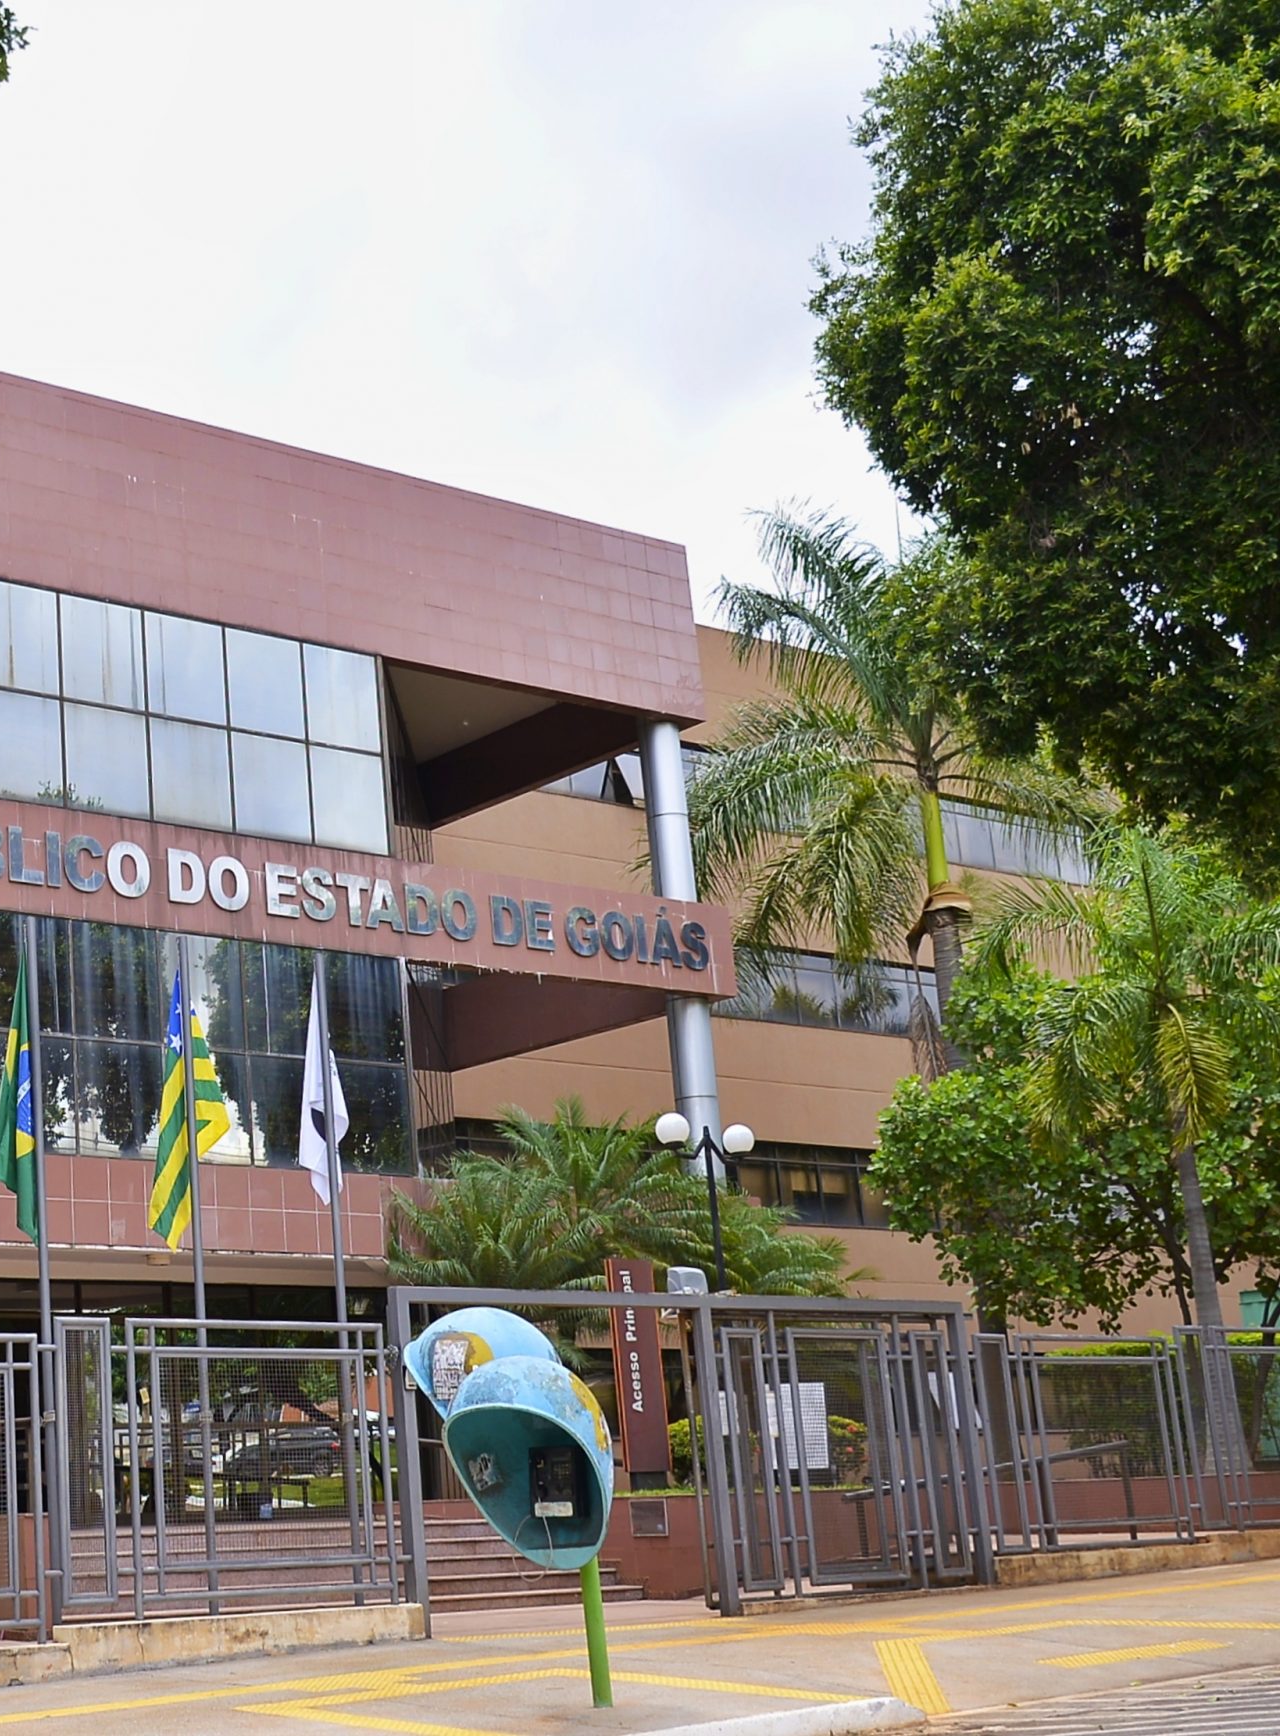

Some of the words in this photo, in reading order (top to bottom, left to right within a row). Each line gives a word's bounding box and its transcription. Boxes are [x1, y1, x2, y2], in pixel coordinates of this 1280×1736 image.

[166, 847, 250, 912] DO
[265, 862, 477, 942] ESTADO
[490, 895, 556, 951] DE
[564, 906, 710, 971] GOIÁS
[619, 1270, 638, 1342] Prinpal
[630, 1352, 644, 1412] Acesso
